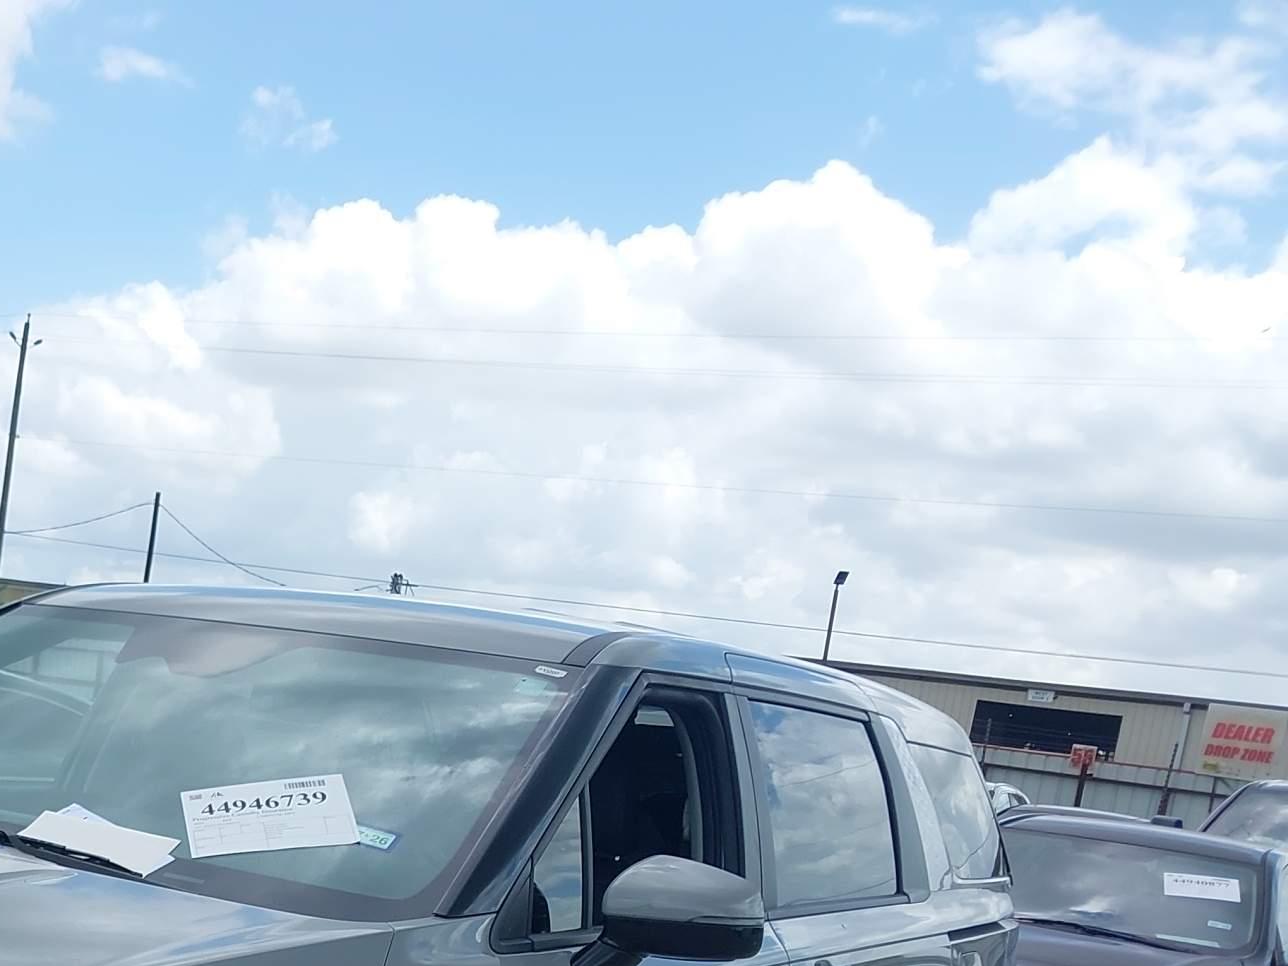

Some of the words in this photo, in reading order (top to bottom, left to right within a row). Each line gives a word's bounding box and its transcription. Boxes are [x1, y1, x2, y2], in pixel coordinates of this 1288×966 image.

[1212, 722, 1275, 744] DEALER
[1204, 743, 1241, 759] DROP
[1240, 747, 1274, 764] ZONE
[201, 791, 327, 816] 44946739
[370, 834, 389, 845] 26
